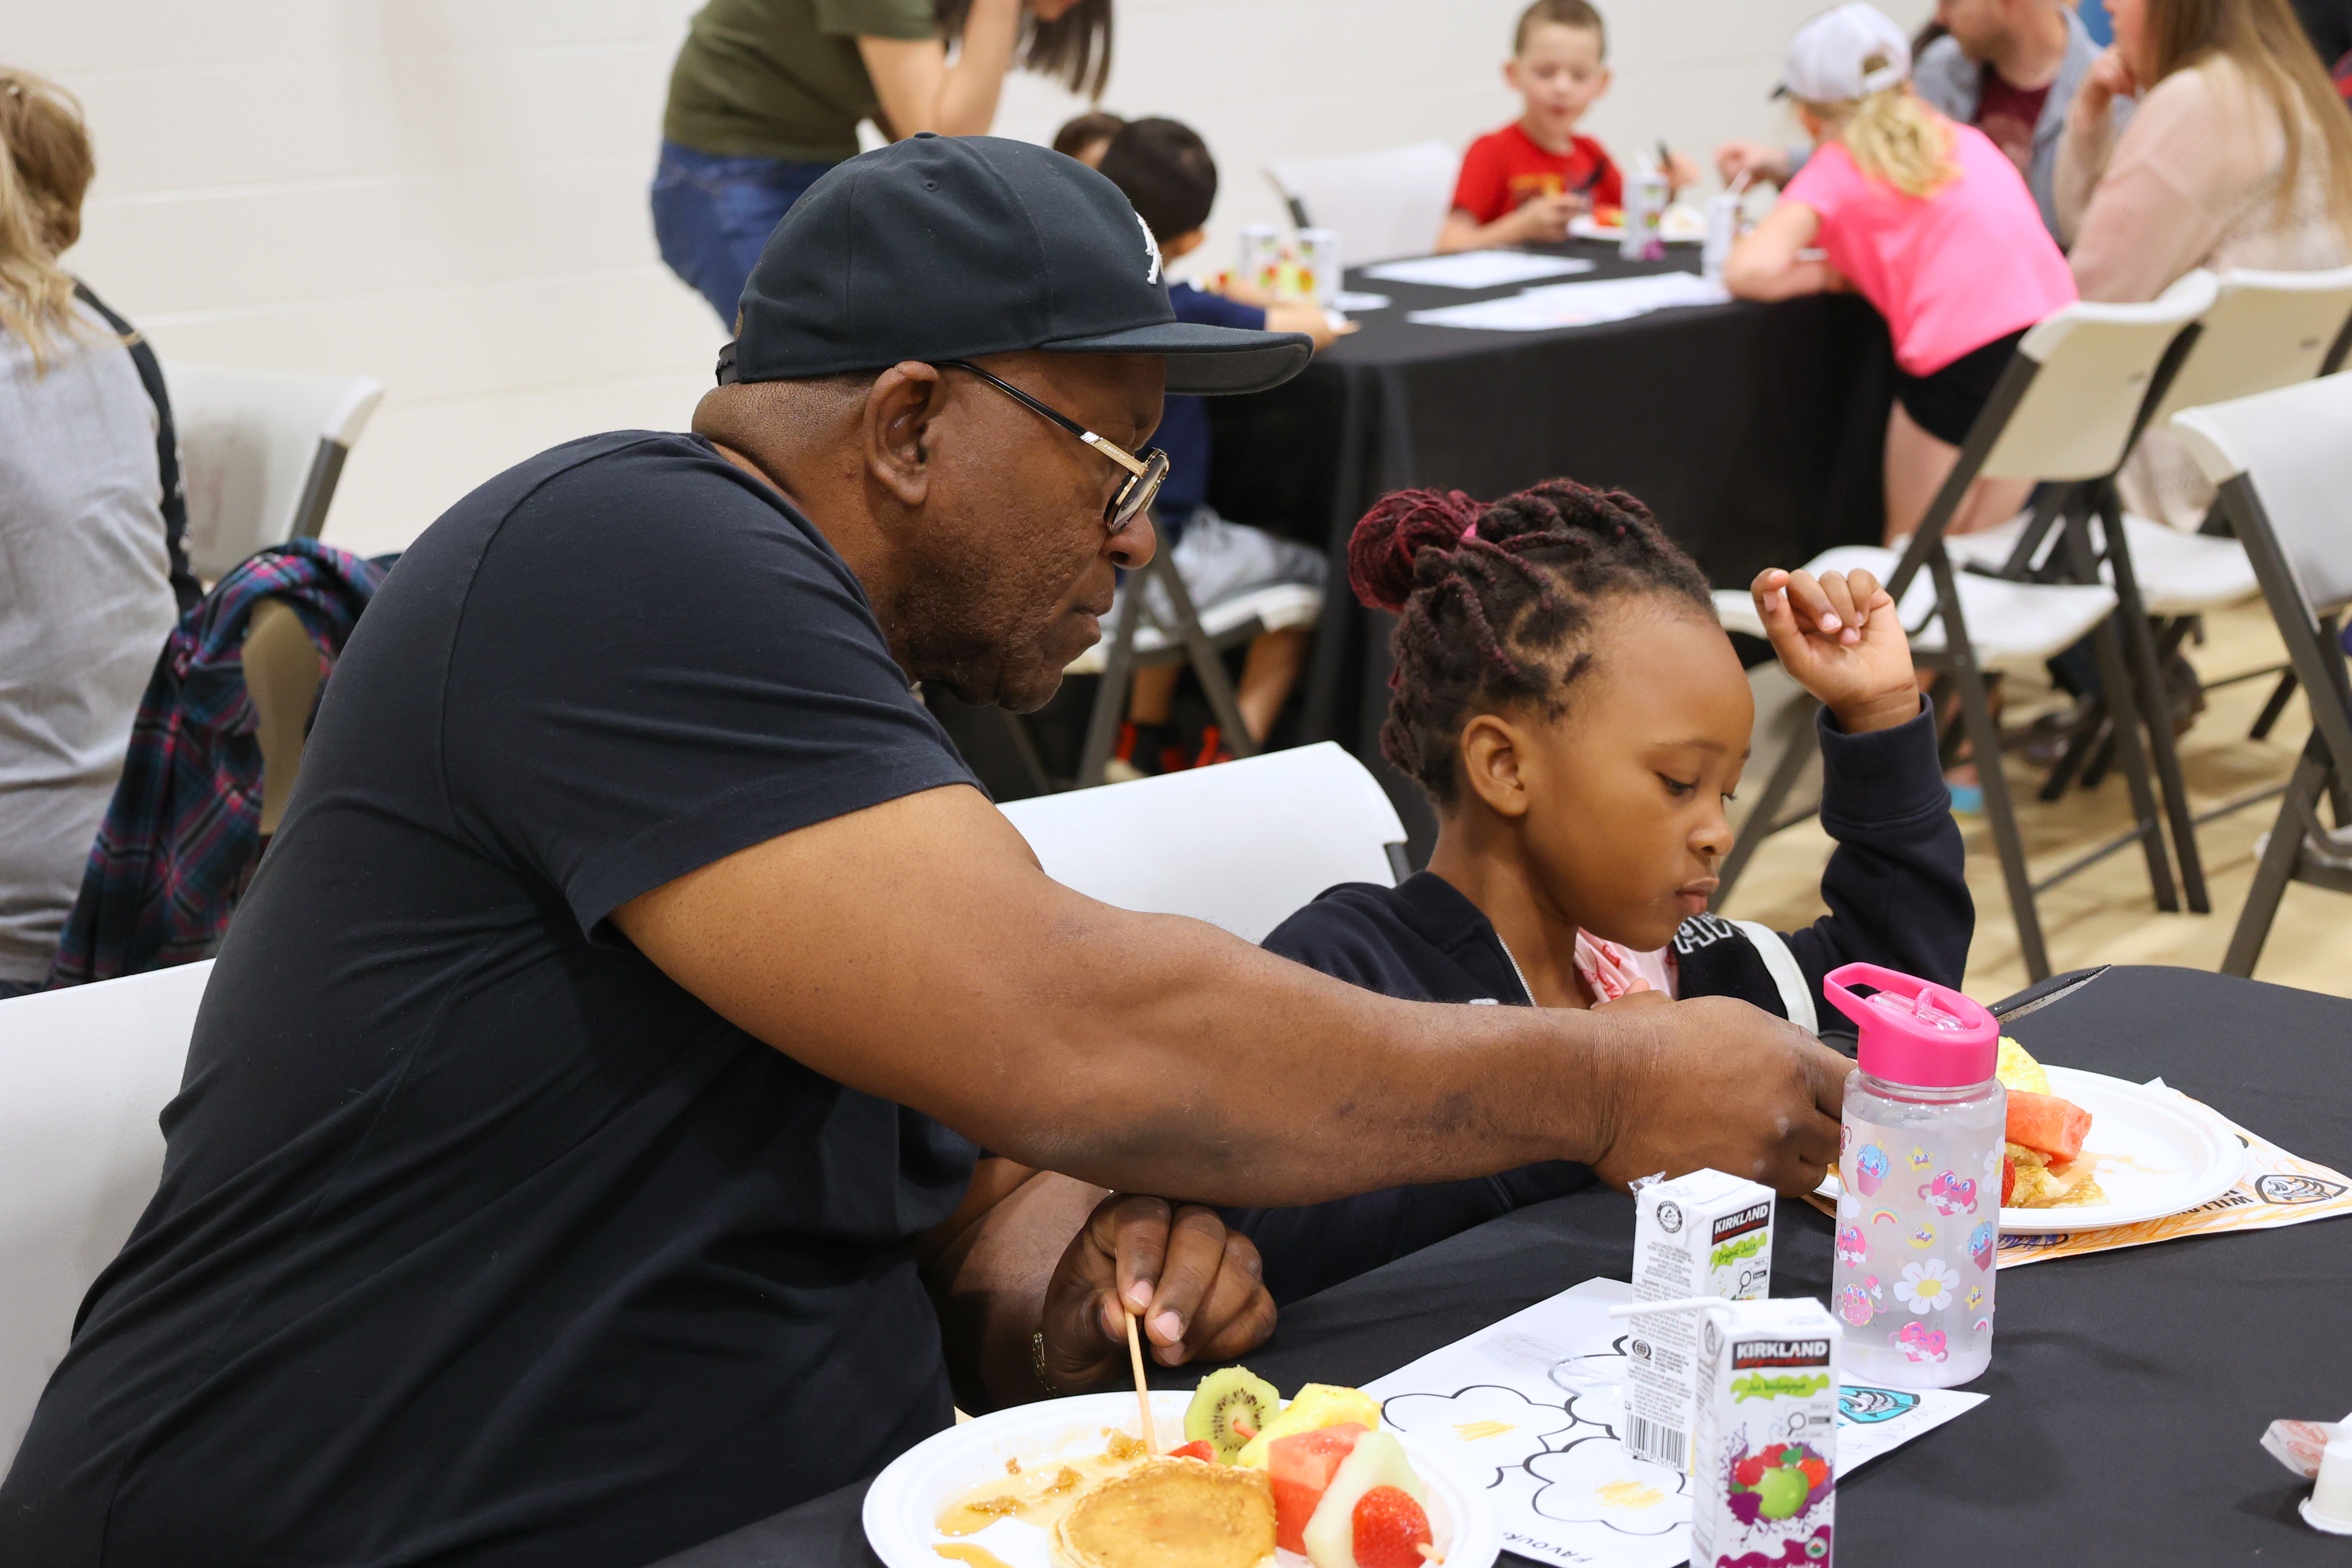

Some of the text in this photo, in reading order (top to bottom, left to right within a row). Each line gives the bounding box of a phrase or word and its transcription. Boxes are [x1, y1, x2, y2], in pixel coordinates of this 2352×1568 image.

[1715, 1205, 1768, 1235] KIRKLAND
[1718, 1243, 1756, 1263] Organic Juice
[1736, 1341, 1828, 1360] KIRKLAND
